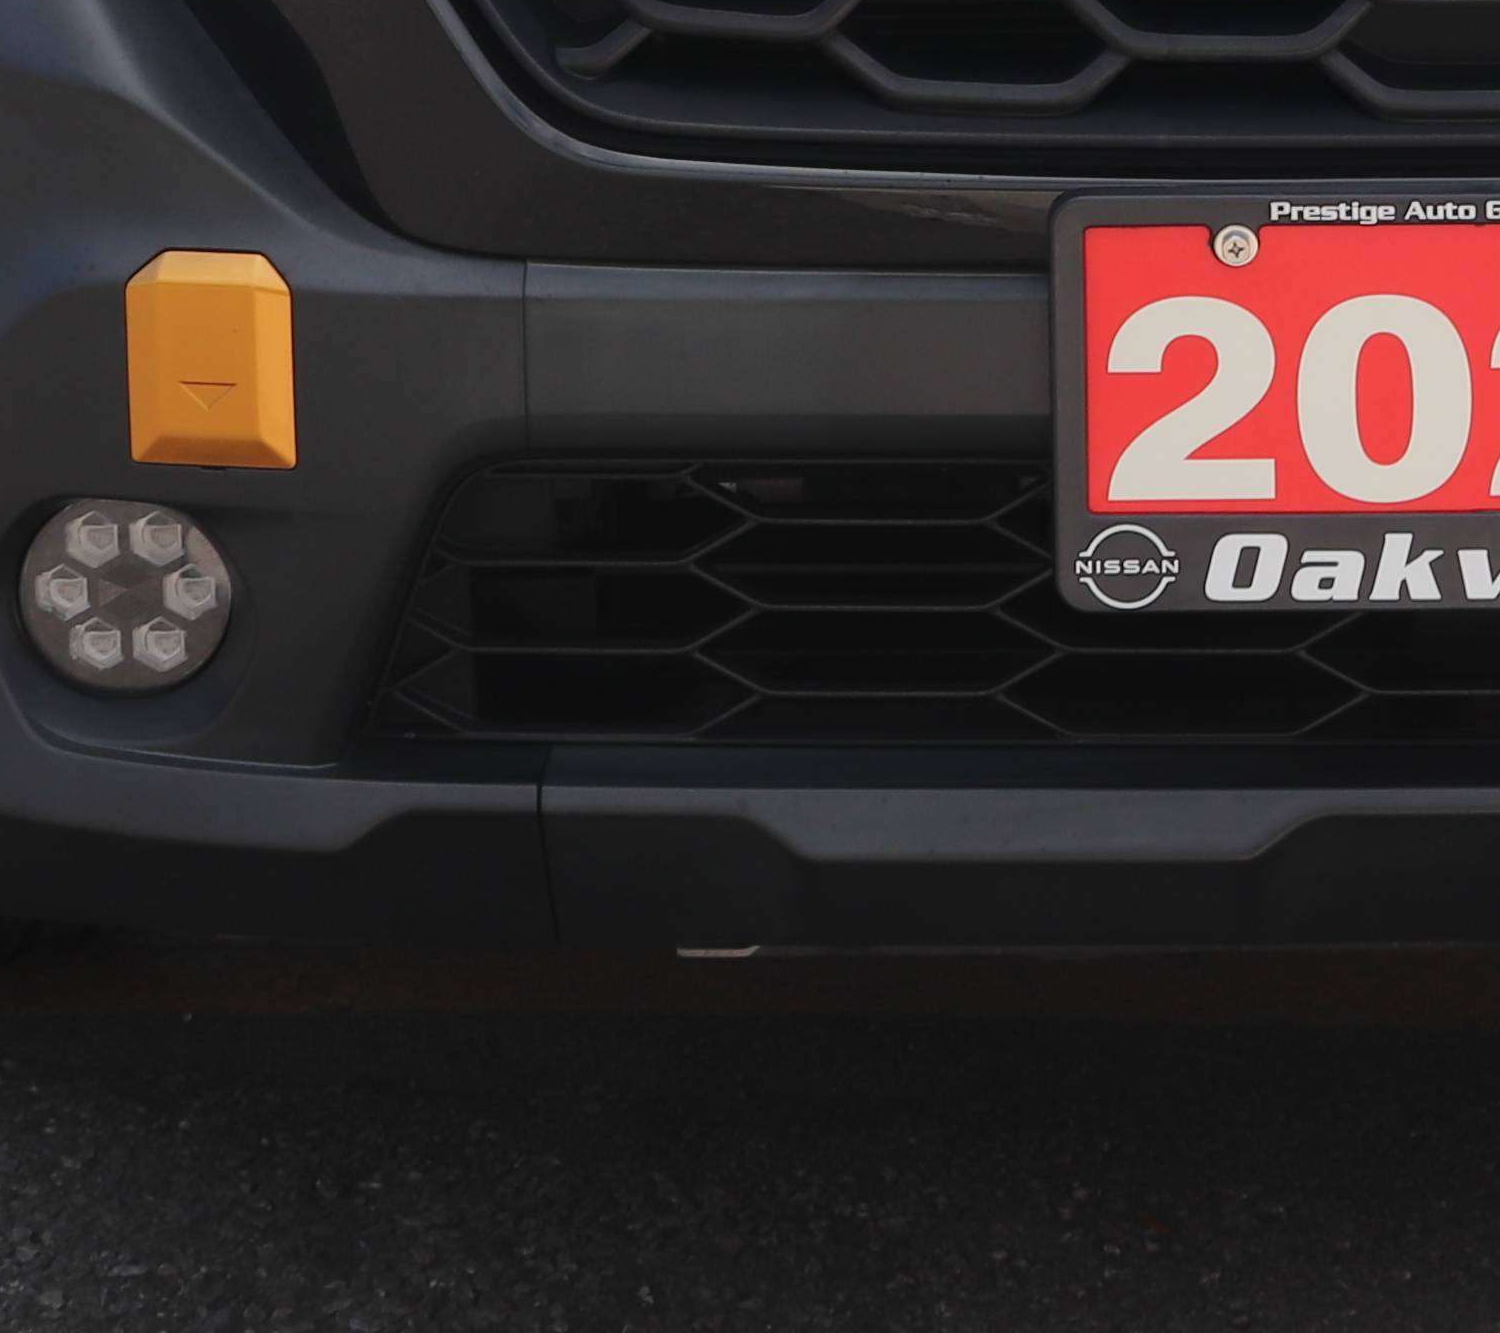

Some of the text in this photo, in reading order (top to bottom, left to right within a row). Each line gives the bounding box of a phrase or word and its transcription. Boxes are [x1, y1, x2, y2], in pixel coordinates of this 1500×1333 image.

[1270, 200, 1396, 225] Prestige
[1405, 200, 1477, 221] Auto
[1075, 559, 1179, 575] NISSAN
